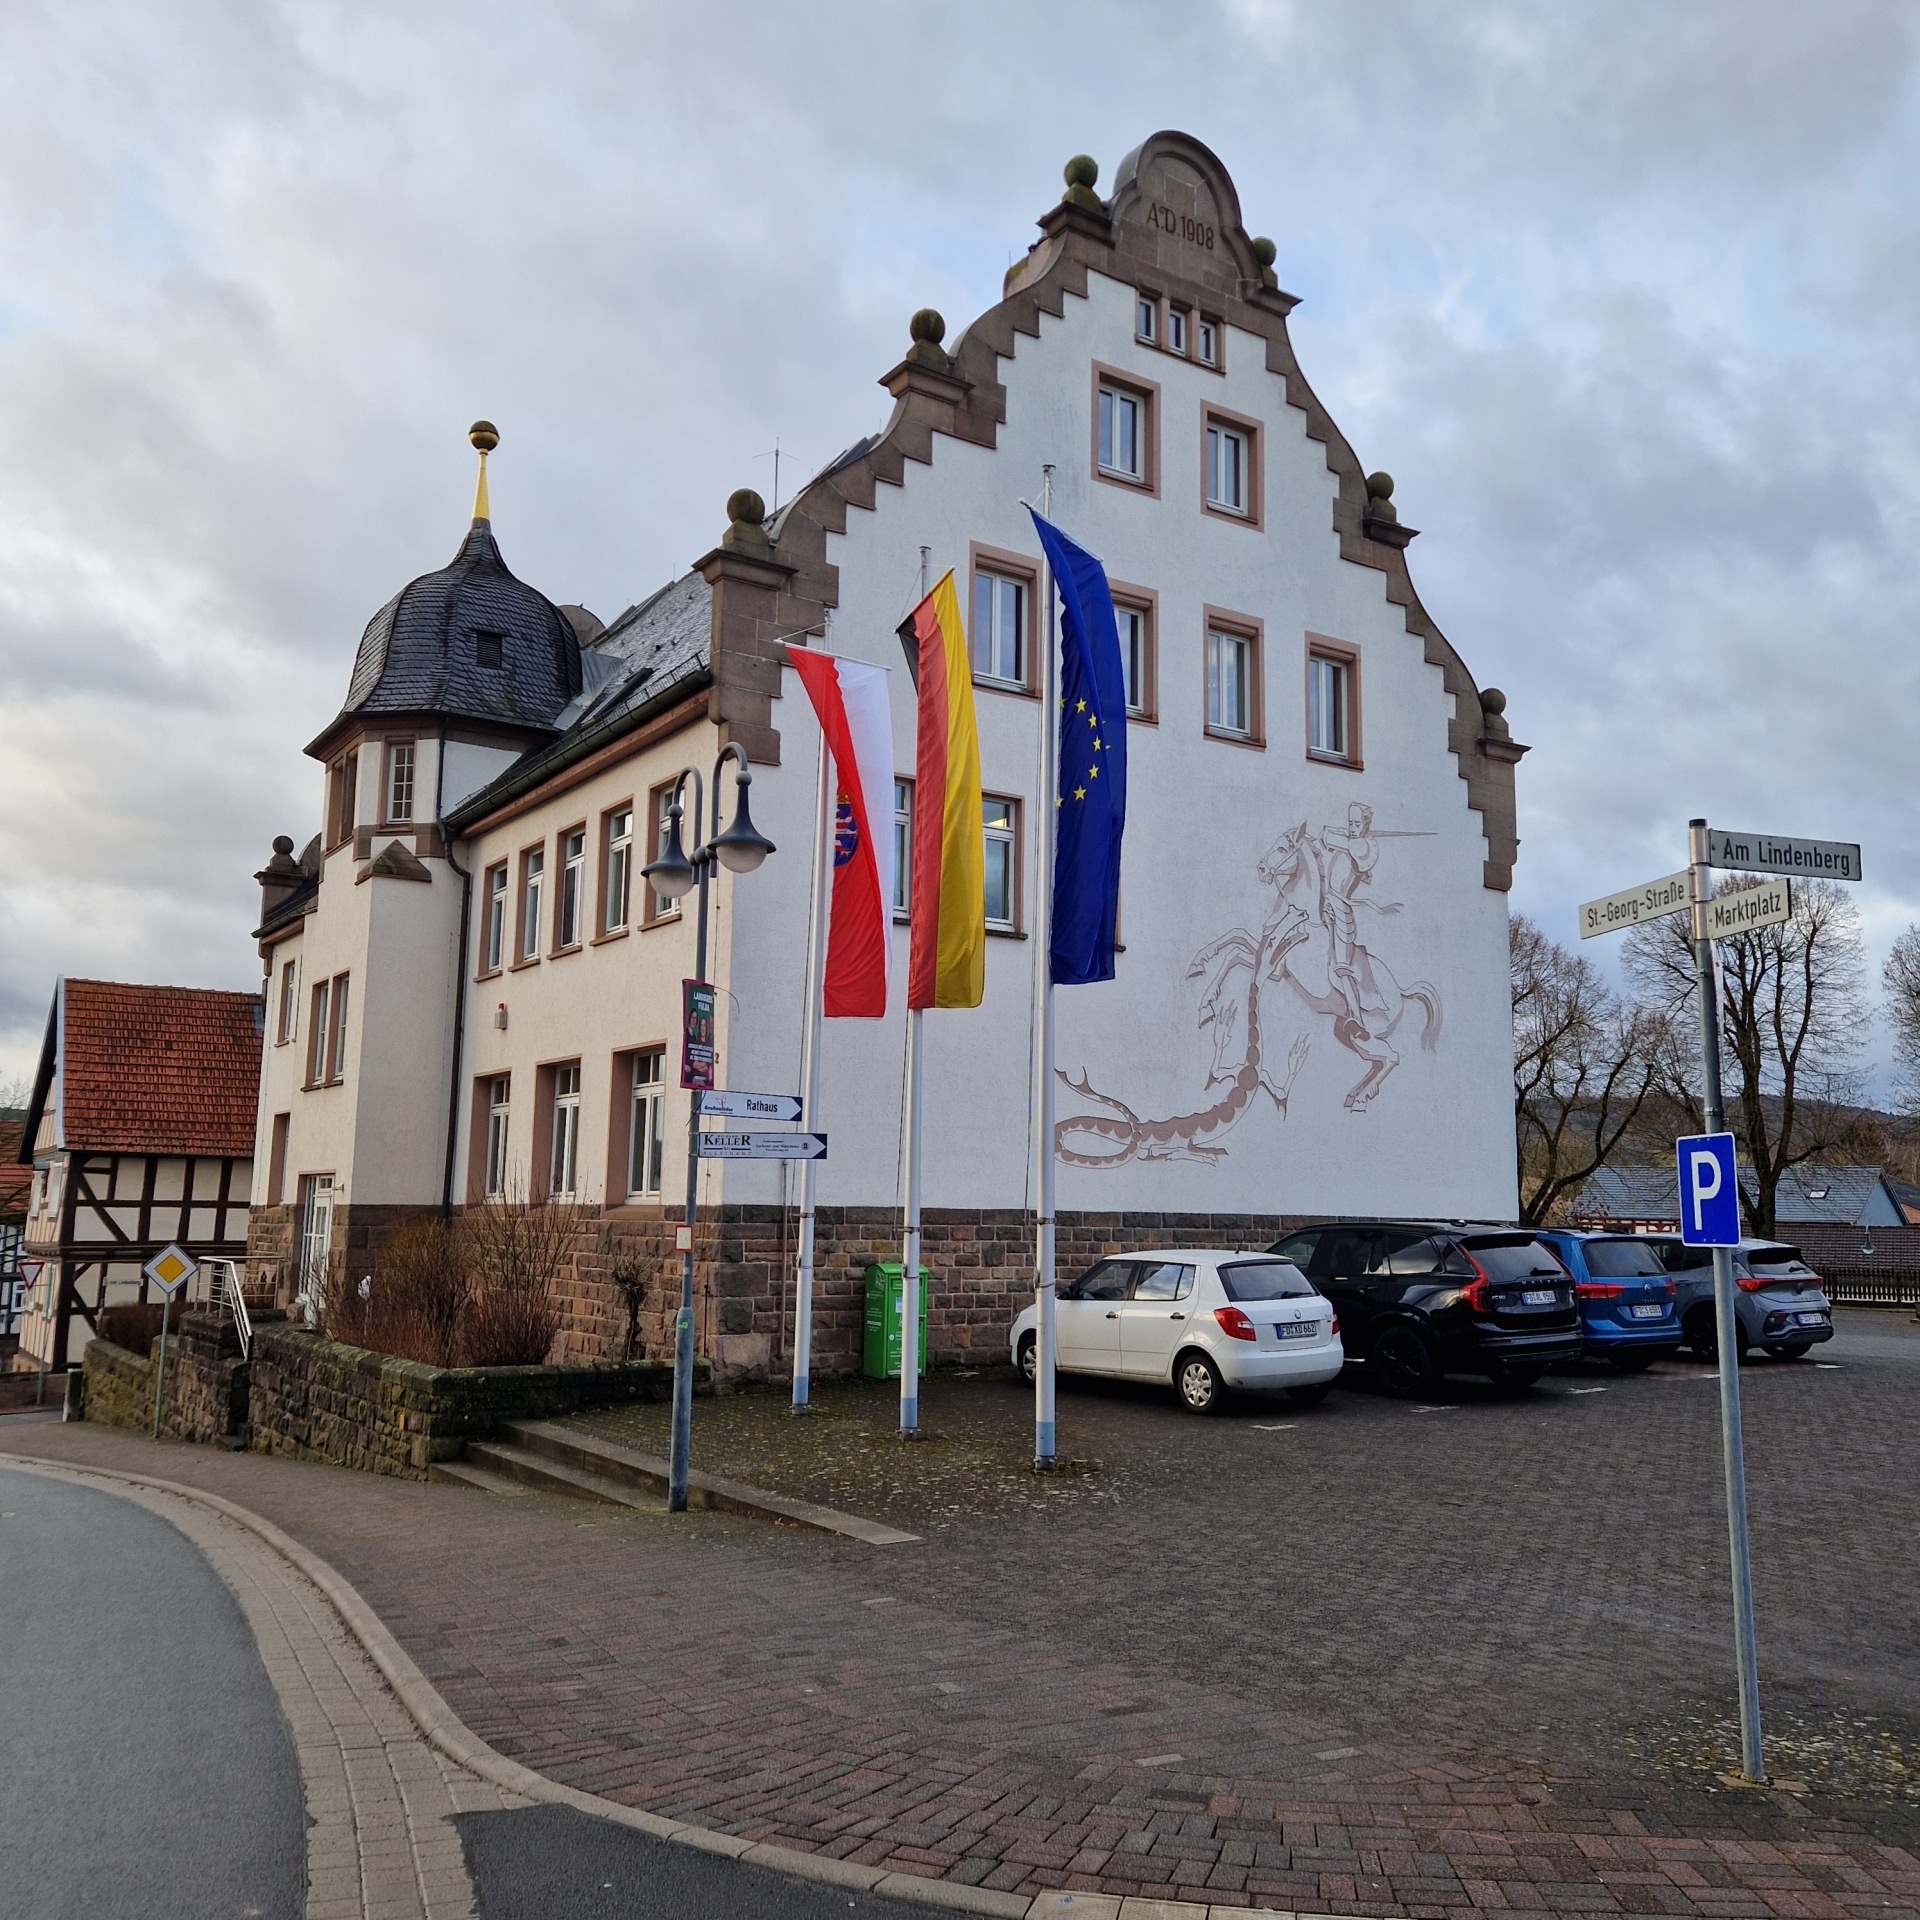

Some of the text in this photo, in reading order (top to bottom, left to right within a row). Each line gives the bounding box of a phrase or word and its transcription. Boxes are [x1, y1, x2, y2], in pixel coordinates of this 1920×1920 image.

[1723, 838, 1850, 877] Am Lindenberg
[1587, 881, 1685, 928] St.-Georg-Straße
[1715, 891, 1782, 928] Marktplatz
[715, 1052, 720, 1064] 2
[746, 1099, 778, 1113] Rathaus
[704, 1134, 751, 1146] KELLER
[1690, 1150, 1722, 1231] P
[1303, 1323, 1315, 1333] 662
